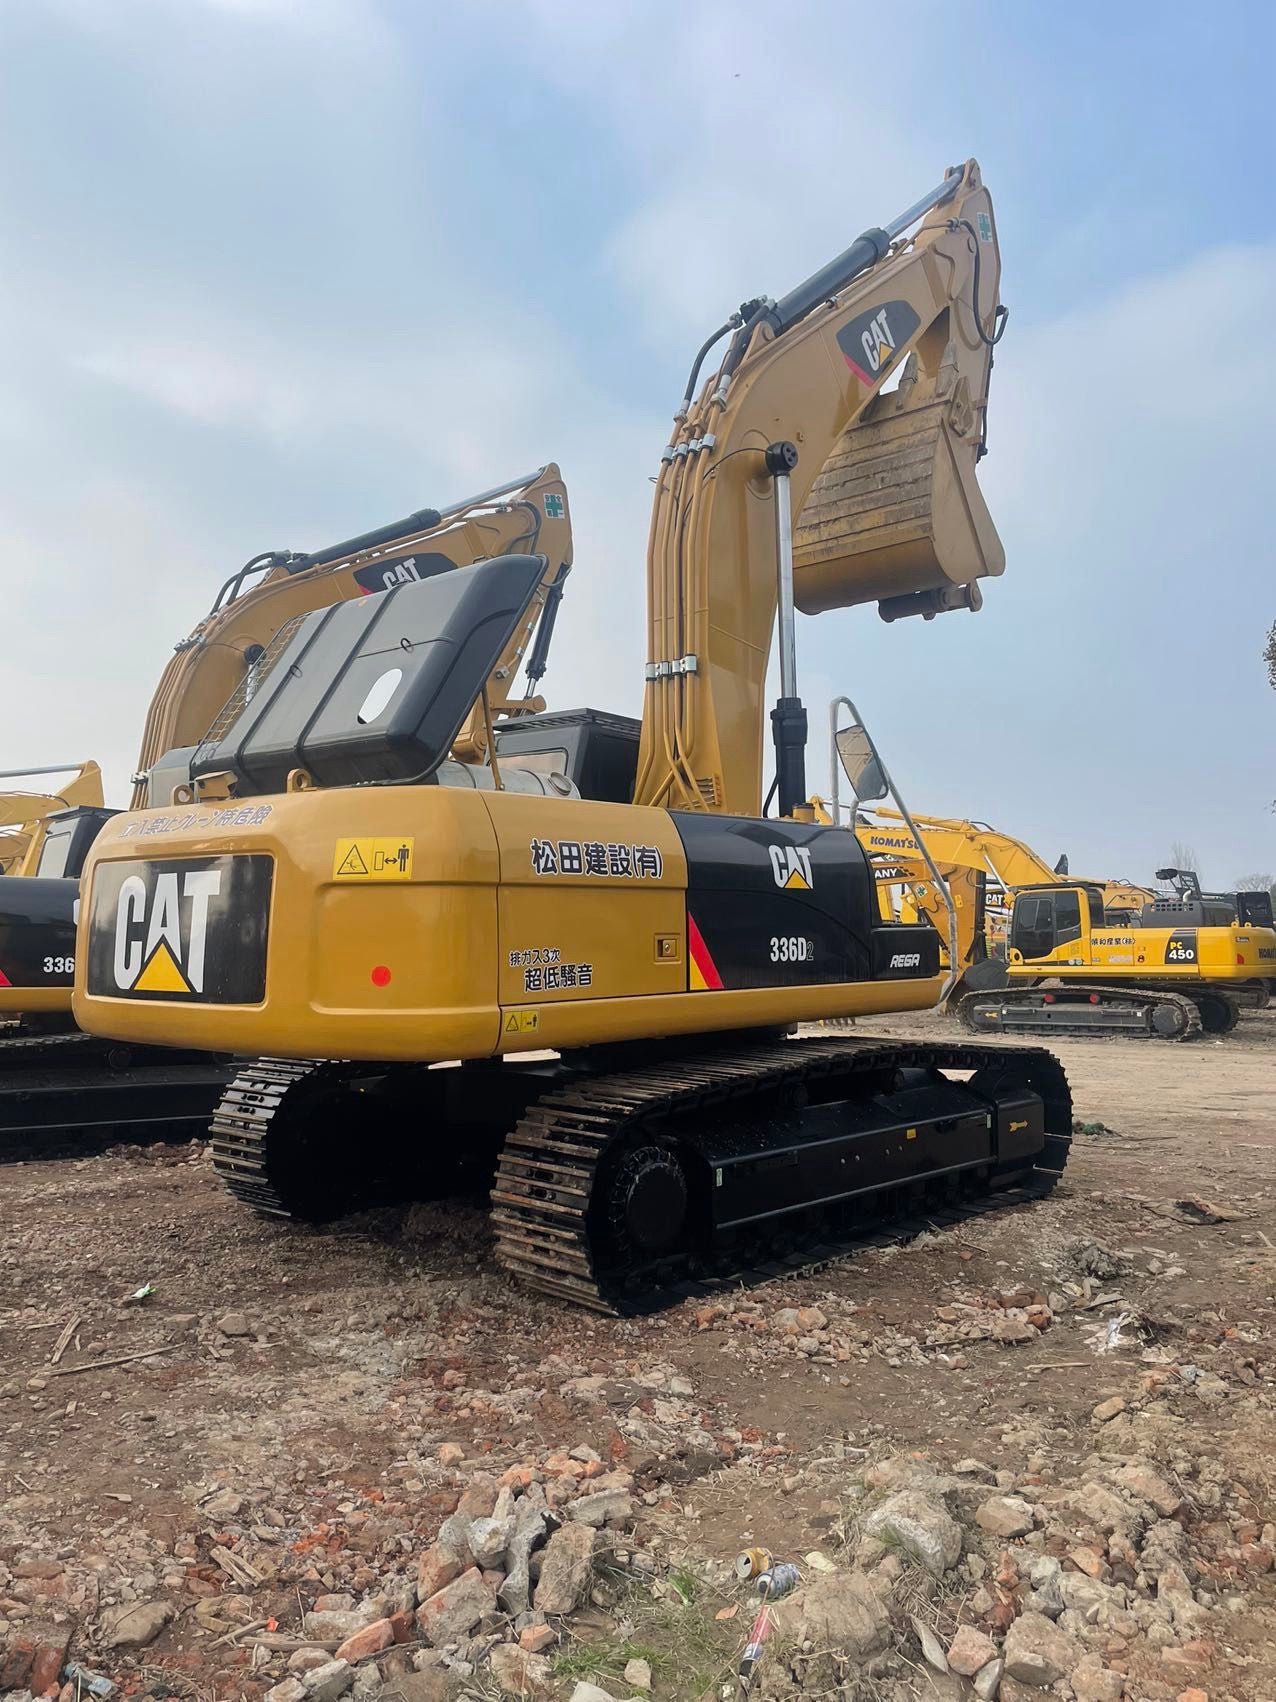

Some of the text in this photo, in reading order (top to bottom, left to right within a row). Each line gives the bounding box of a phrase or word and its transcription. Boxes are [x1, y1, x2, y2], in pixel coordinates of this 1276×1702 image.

[861, 308, 896, 371] CAT
[382, 558, 423, 590] CAT
[530, 838, 663, 878] 松田建設(有)
[768, 845, 813, 889] CAT
[874, 868, 897, 878] ANY
[985, 893, 1003, 905] CAT
[114, 870, 221, 993] CAT
[43, 957, 75, 973] 336
[510, 948, 561, 966] 排ガス3次
[1168, 950, 1194, 960] 450
